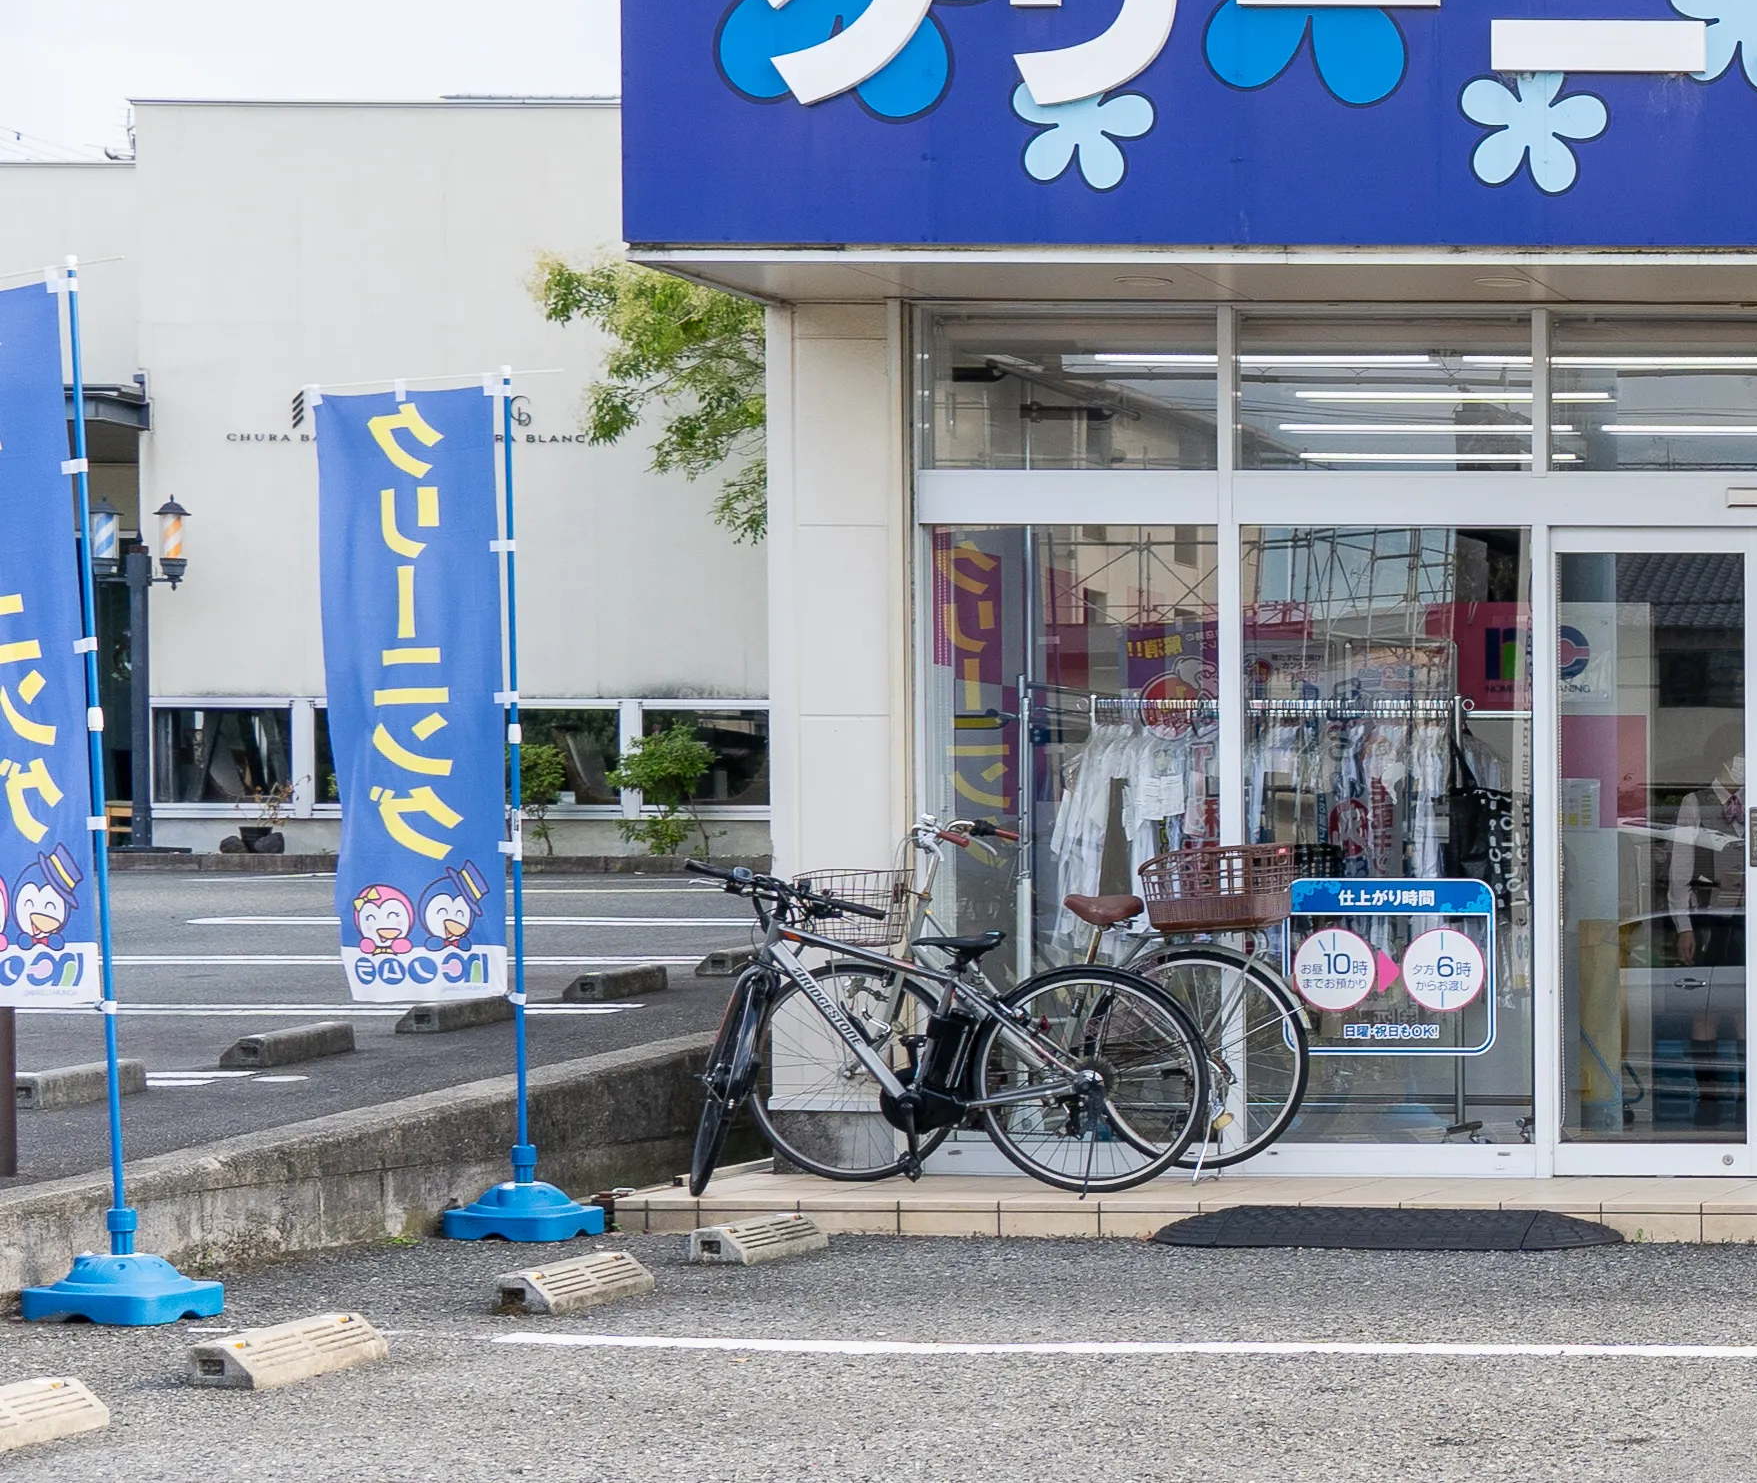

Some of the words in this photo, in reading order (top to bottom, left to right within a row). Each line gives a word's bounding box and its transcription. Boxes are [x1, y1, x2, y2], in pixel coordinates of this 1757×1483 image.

[227, 433, 290, 442] CHURA
[1338, 889, 1435, 906] 仕上がり時間
[1301, 953, 1368, 976] お昼10時
[1413, 955, 1471, 978] 夕方6時
[1302, 978, 1367, 989] までお預かり
[1416, 981, 1470, 992] からお渡し
[791, 967, 863, 1047] BRIDGESTONE
